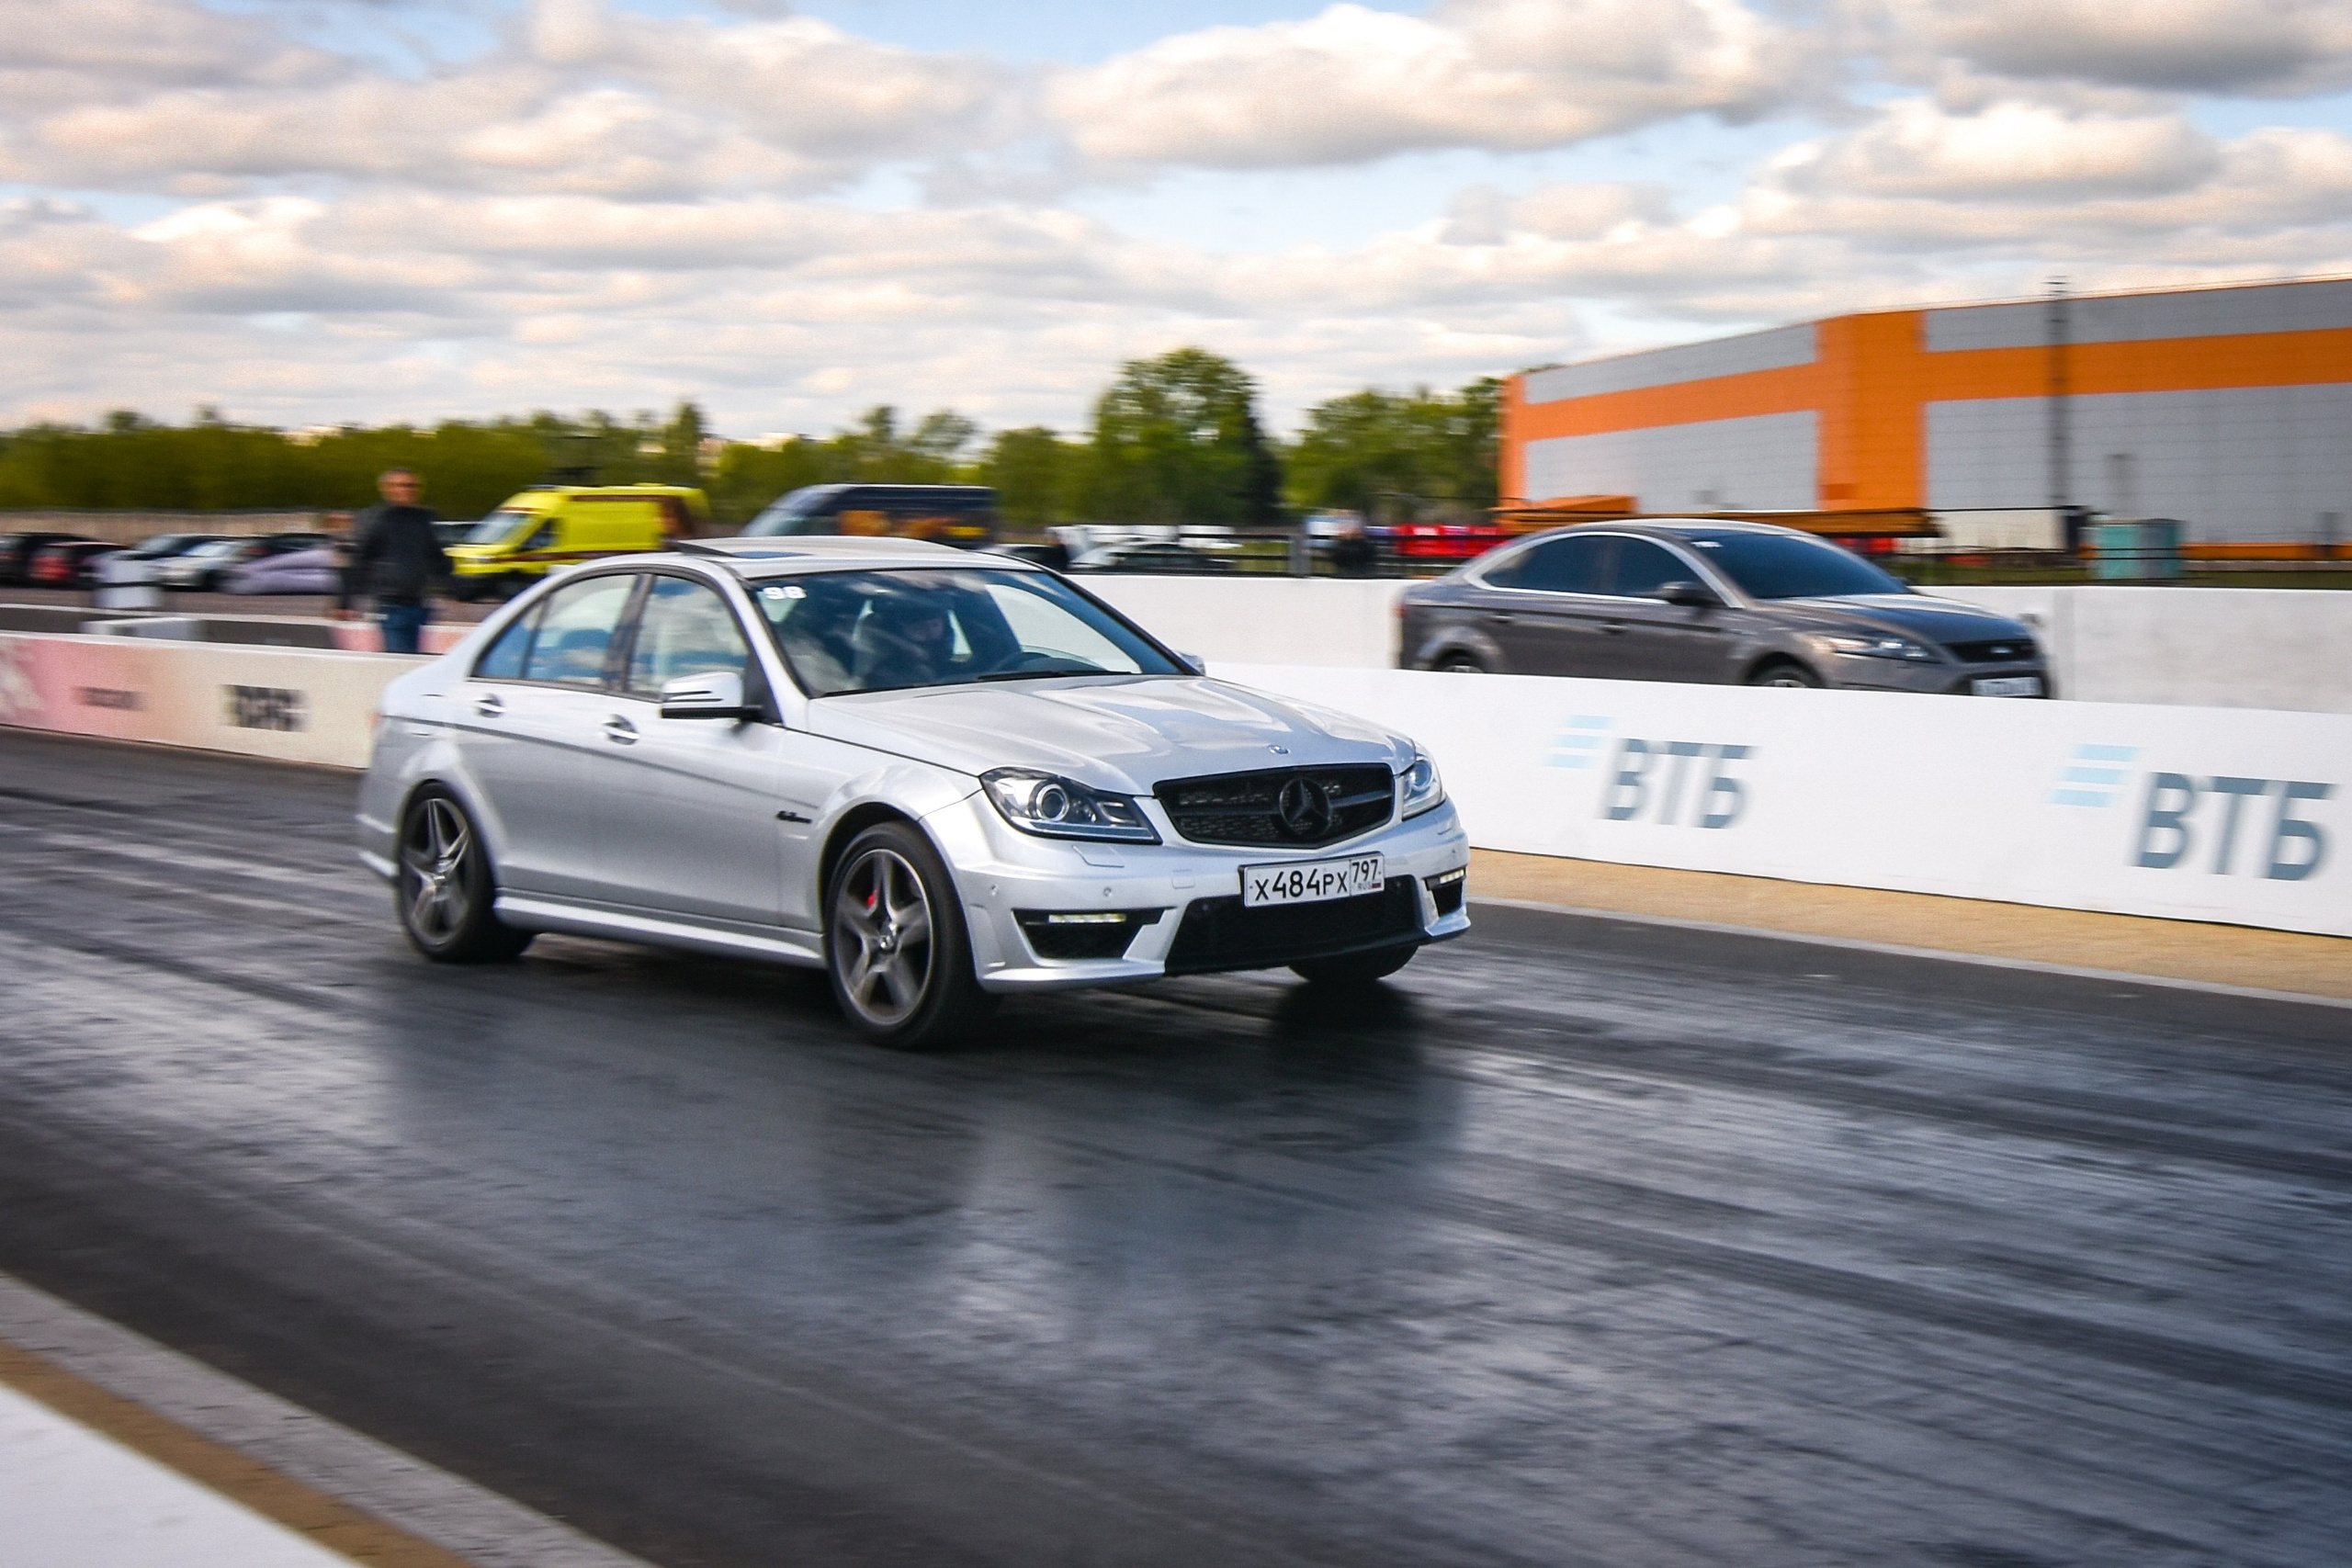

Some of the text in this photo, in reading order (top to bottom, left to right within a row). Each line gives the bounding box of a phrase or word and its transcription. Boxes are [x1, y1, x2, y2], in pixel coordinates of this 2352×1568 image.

[1598, 738, 1755, 829] ВТБ
[2127, 771, 2339, 882] ВТБ
[1351, 859, 1378, 883] 797
